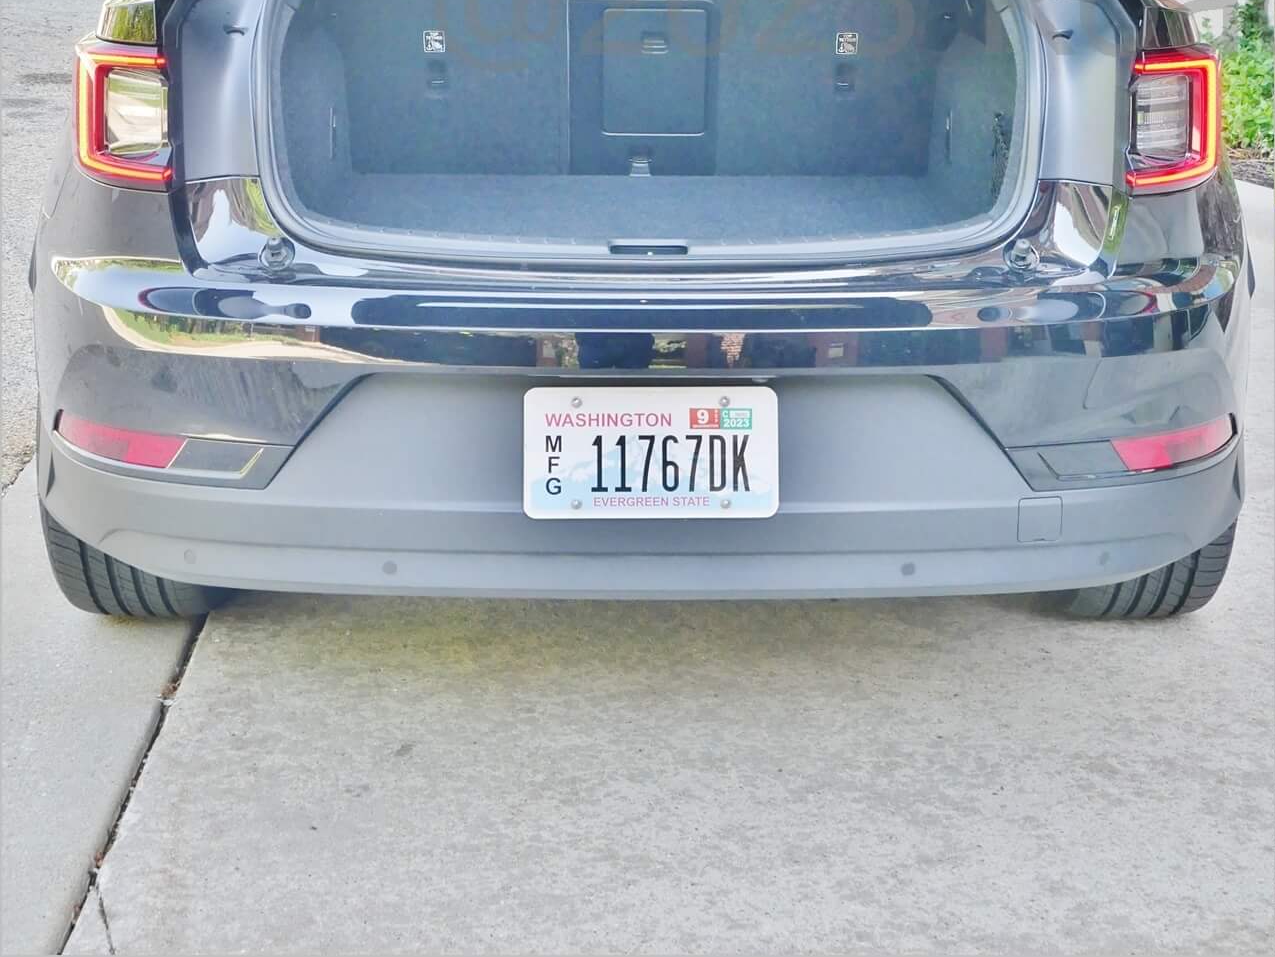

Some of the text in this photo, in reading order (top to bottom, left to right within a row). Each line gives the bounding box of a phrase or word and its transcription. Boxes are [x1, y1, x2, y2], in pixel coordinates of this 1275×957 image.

[545, 413, 672, 428] WASHINGTON
[697, 409, 709, 424] 9
[723, 418, 750, 428] 2023
[591, 434, 751, 493] 11767DK
[593, 496, 710, 507] EVERGREEN STATE
